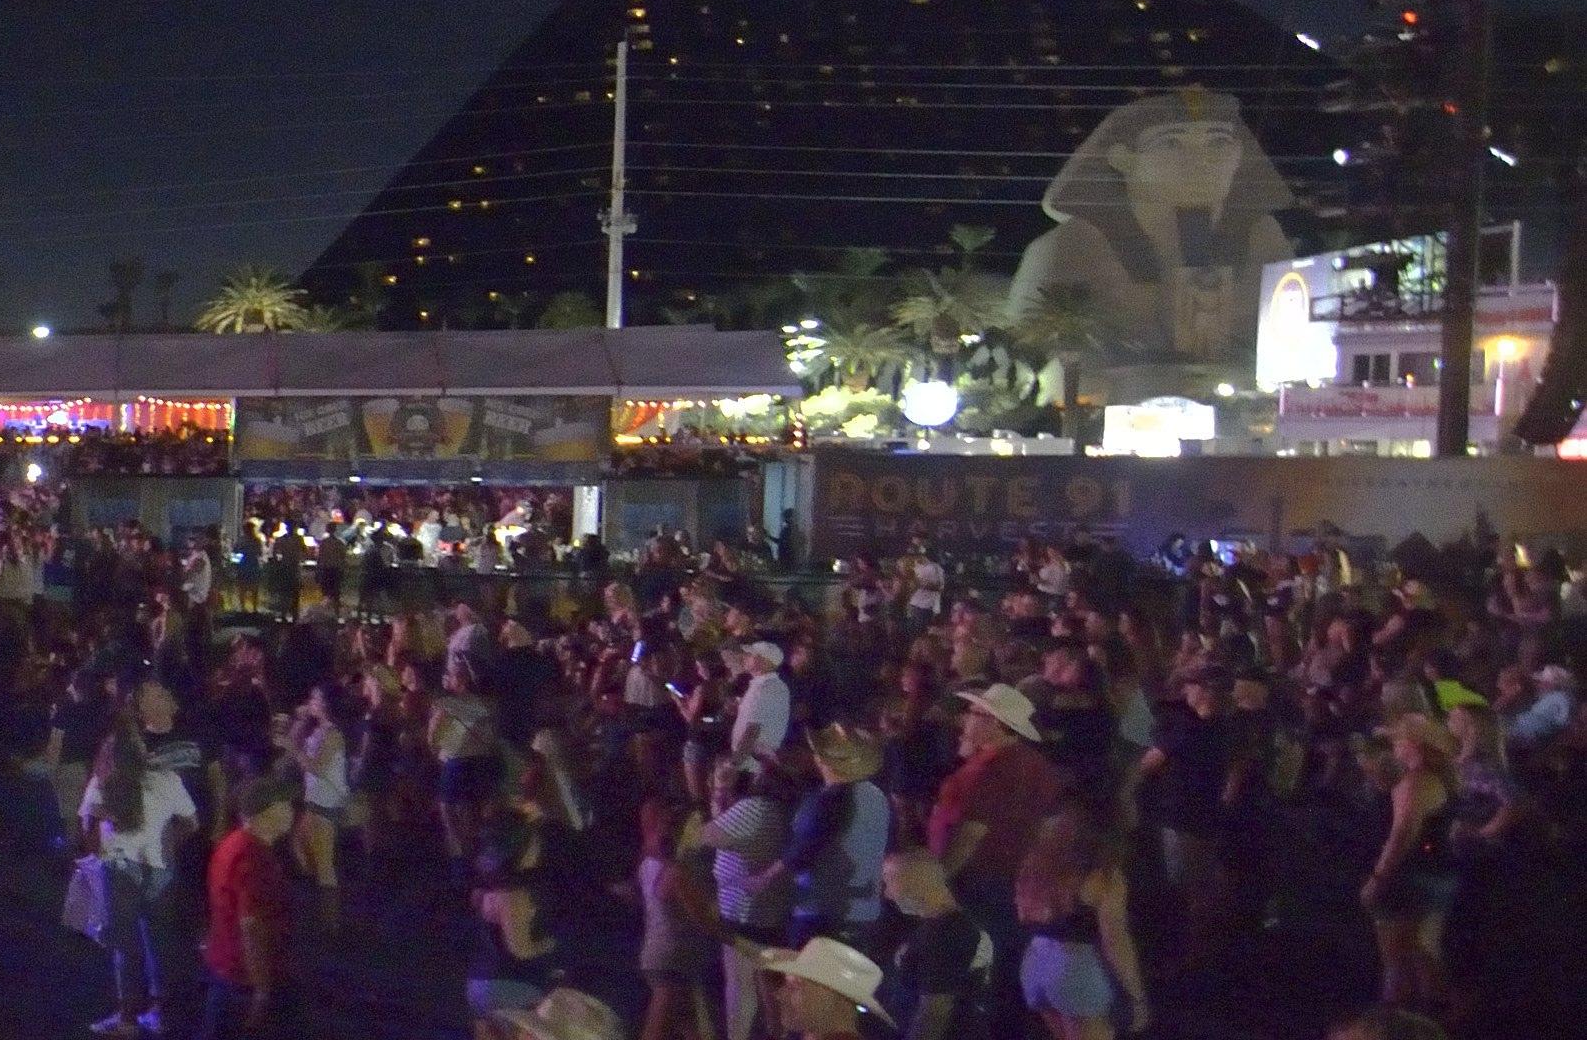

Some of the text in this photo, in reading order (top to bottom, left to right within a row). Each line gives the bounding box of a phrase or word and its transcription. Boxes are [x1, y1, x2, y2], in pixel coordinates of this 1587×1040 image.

[826, 472, 1133, 517] ROUTE 91
[874, 519, 1080, 541] HARVEST
